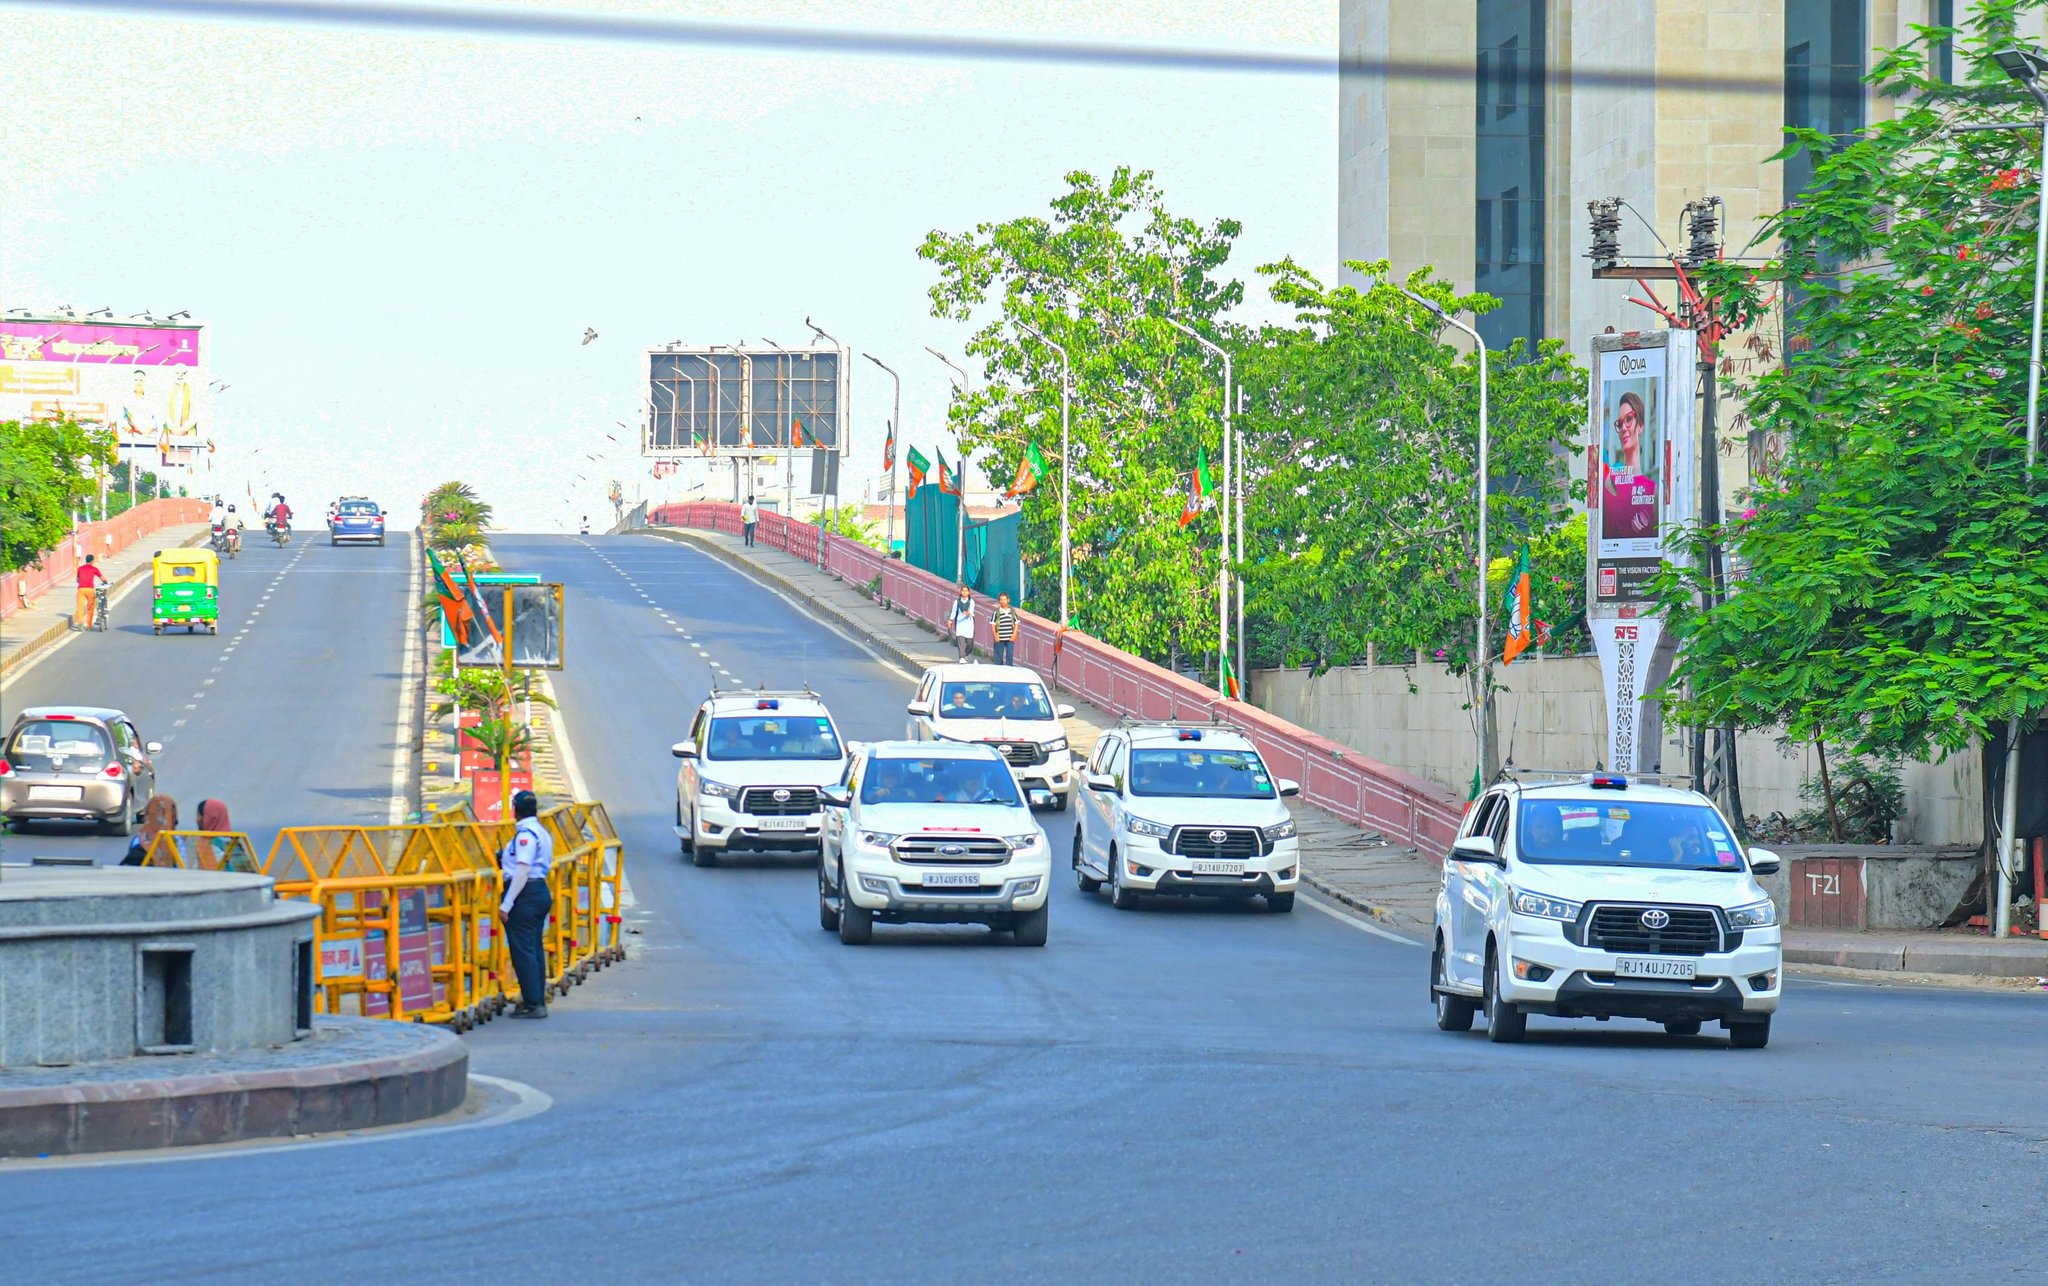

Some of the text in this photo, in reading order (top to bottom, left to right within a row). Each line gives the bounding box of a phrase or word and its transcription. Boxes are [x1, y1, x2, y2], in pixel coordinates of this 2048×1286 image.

[1619, 355, 1646, 375] NOVA
[1609, 466, 1627, 475] TRUSTED
[1614, 475, 1635, 485] MILLIONS
[1631, 495, 1655, 505] COUNTRIES
[1198, 864, 1243, 873] RJ14UJ7207
[928, 875, 978, 884] RJ14UF6165
[1806, 873, 1840, 896] T-21
[1624, 961, 1693, 976] RJ14UJ7205
